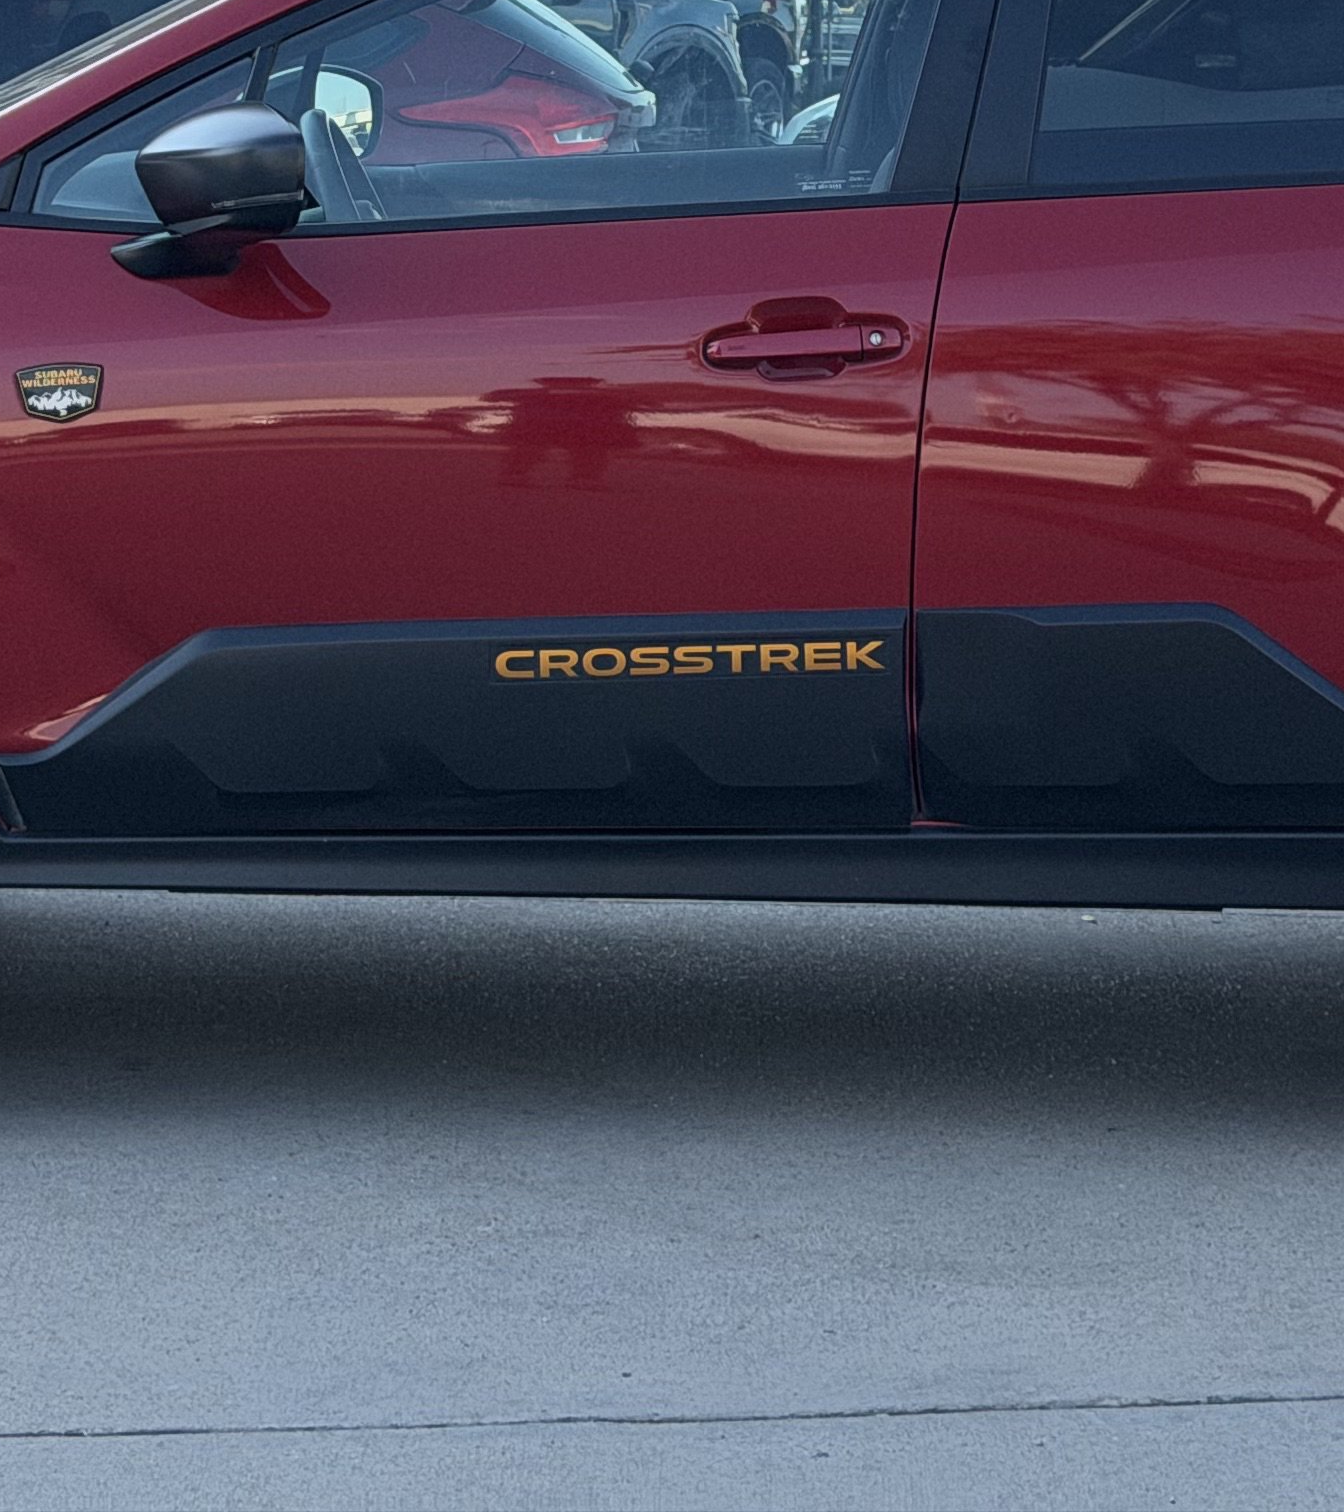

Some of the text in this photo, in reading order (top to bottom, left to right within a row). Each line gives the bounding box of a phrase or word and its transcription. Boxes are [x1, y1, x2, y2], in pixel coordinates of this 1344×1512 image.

[35, 368, 82, 379] SUBARU
[22, 375, 95, 388] WILDERNESS
[495, 641, 885, 678] CROSSTREK
